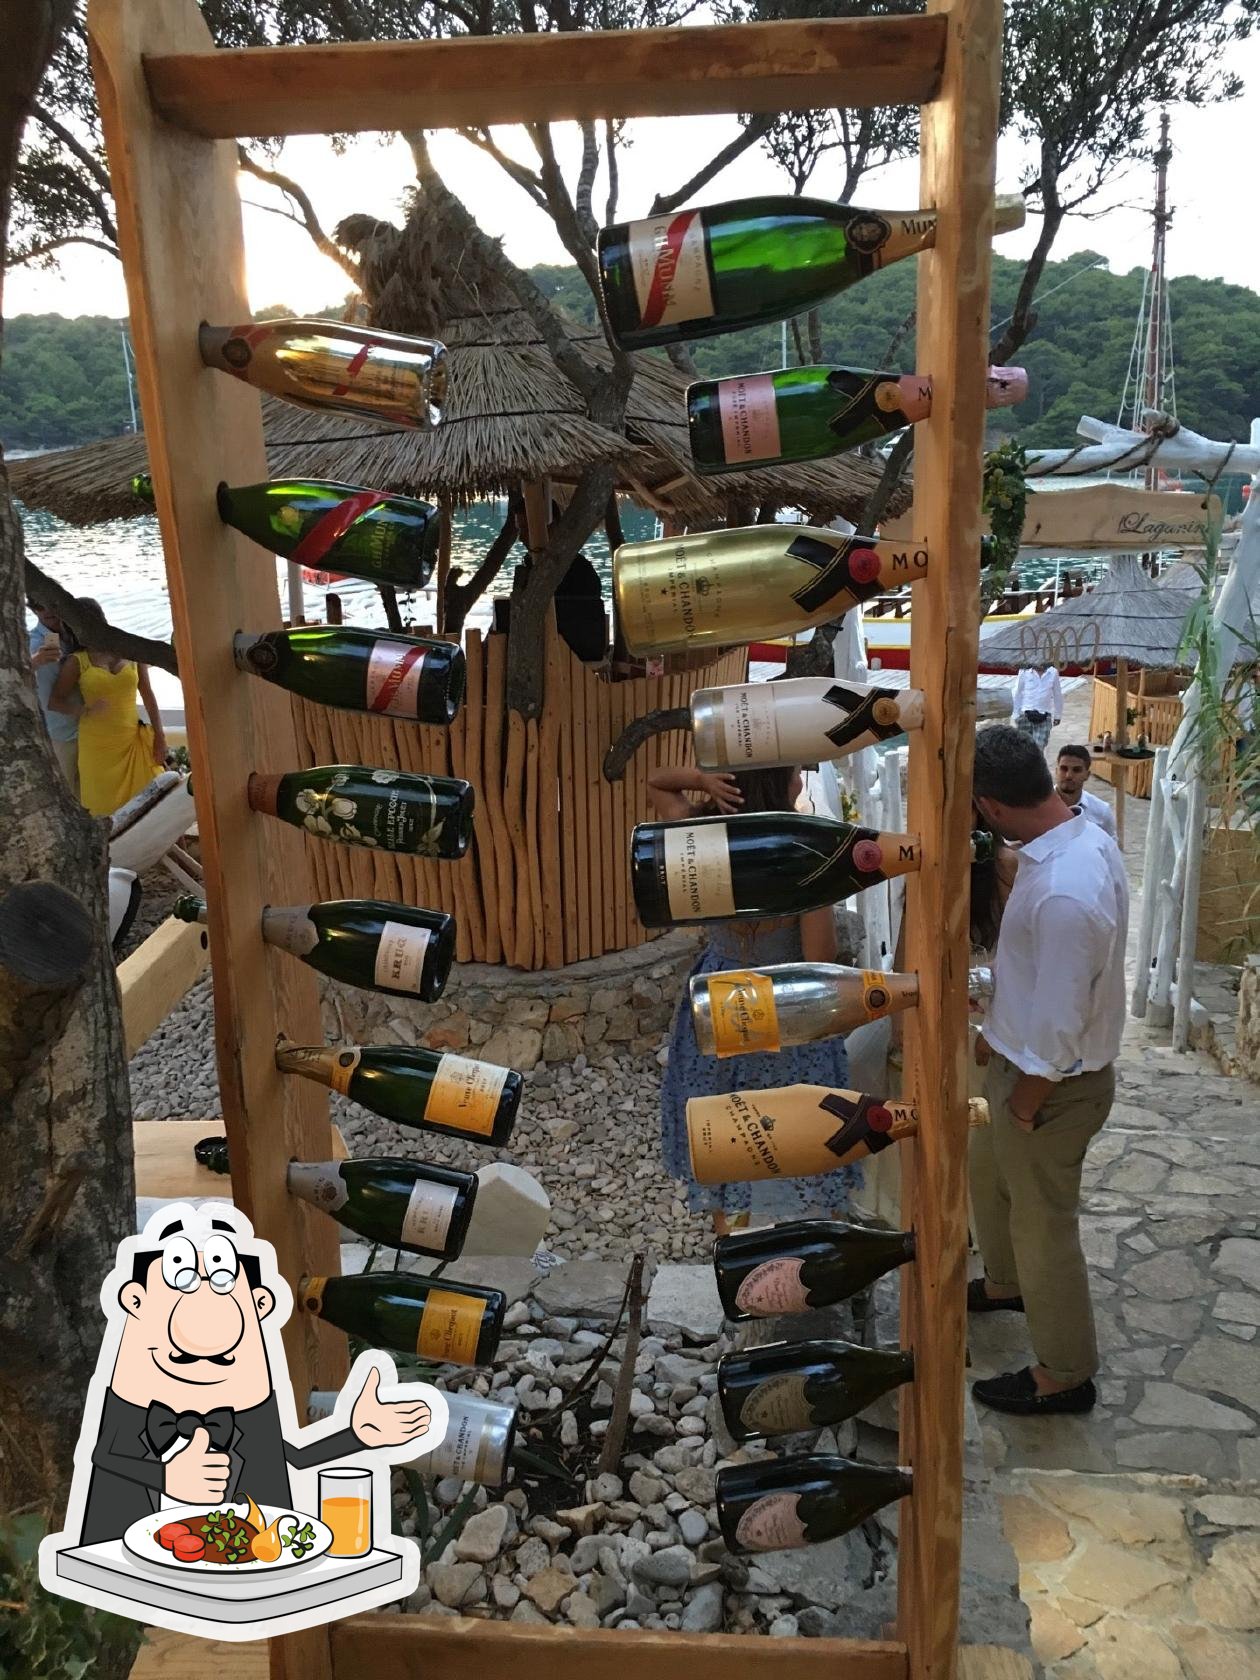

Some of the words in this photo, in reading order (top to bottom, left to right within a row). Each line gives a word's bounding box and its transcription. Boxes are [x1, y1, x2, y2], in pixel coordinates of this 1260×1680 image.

[740, 411, 752, 454] CHANDON
[742, 719, 753, 758] CHANDON
[688, 866, 701, 913] CHANDON
[391, 936, 407, 979] KRUG
[726, 1105, 760, 1166] CHAMPAGNE
[747, 1122, 780, 1174] CHANDON
[456, 1416, 469, 1455] CHANDON
